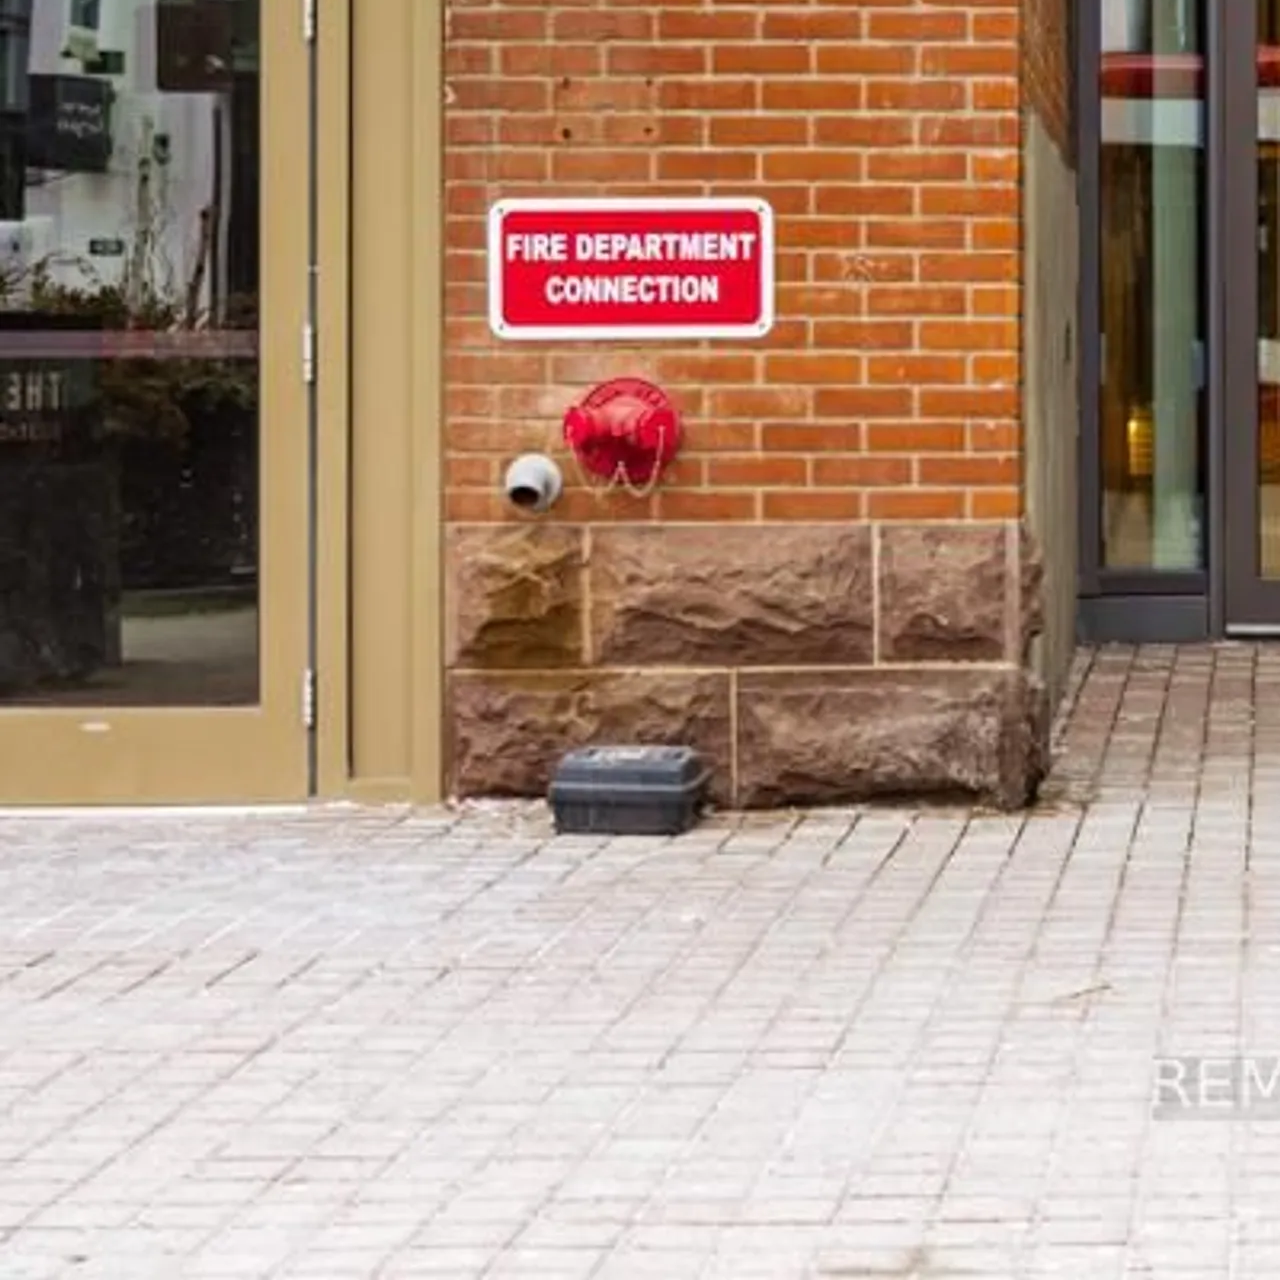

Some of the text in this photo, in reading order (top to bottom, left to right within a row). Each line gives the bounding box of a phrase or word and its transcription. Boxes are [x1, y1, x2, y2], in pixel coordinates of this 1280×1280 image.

[506, 232, 756, 261] FIRE DEPARTMENT
[545, 275, 719, 303] CONNECTION
